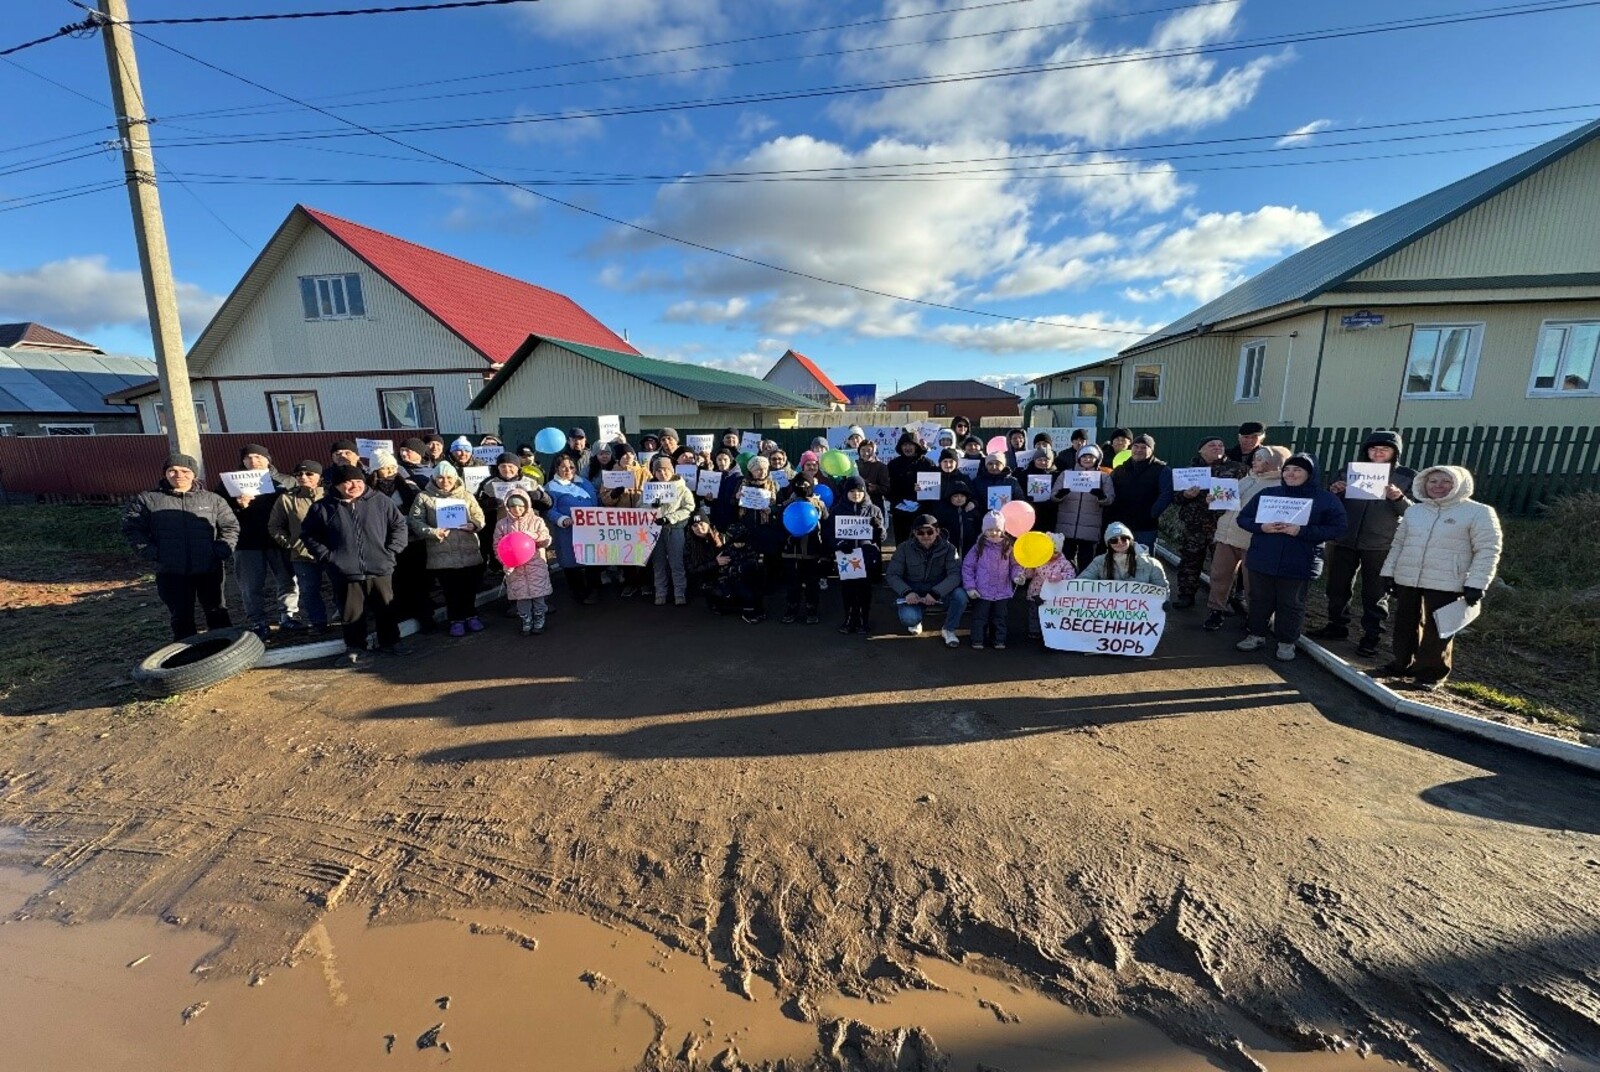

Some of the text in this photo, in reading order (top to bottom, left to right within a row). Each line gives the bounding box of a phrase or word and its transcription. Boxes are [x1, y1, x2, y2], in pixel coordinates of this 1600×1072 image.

[574, 509, 658, 526] ВЕСЕННИХ
[598, 528, 632, 541] ЗОРЬ
[837, 528, 859, 536] 2026
[1066, 580, 1166, 595] ППМИ 2026
[1060, 617, 1159, 637] ВЕСЕННИХ
[1096, 638, 1145, 654] ЗОРЬ
